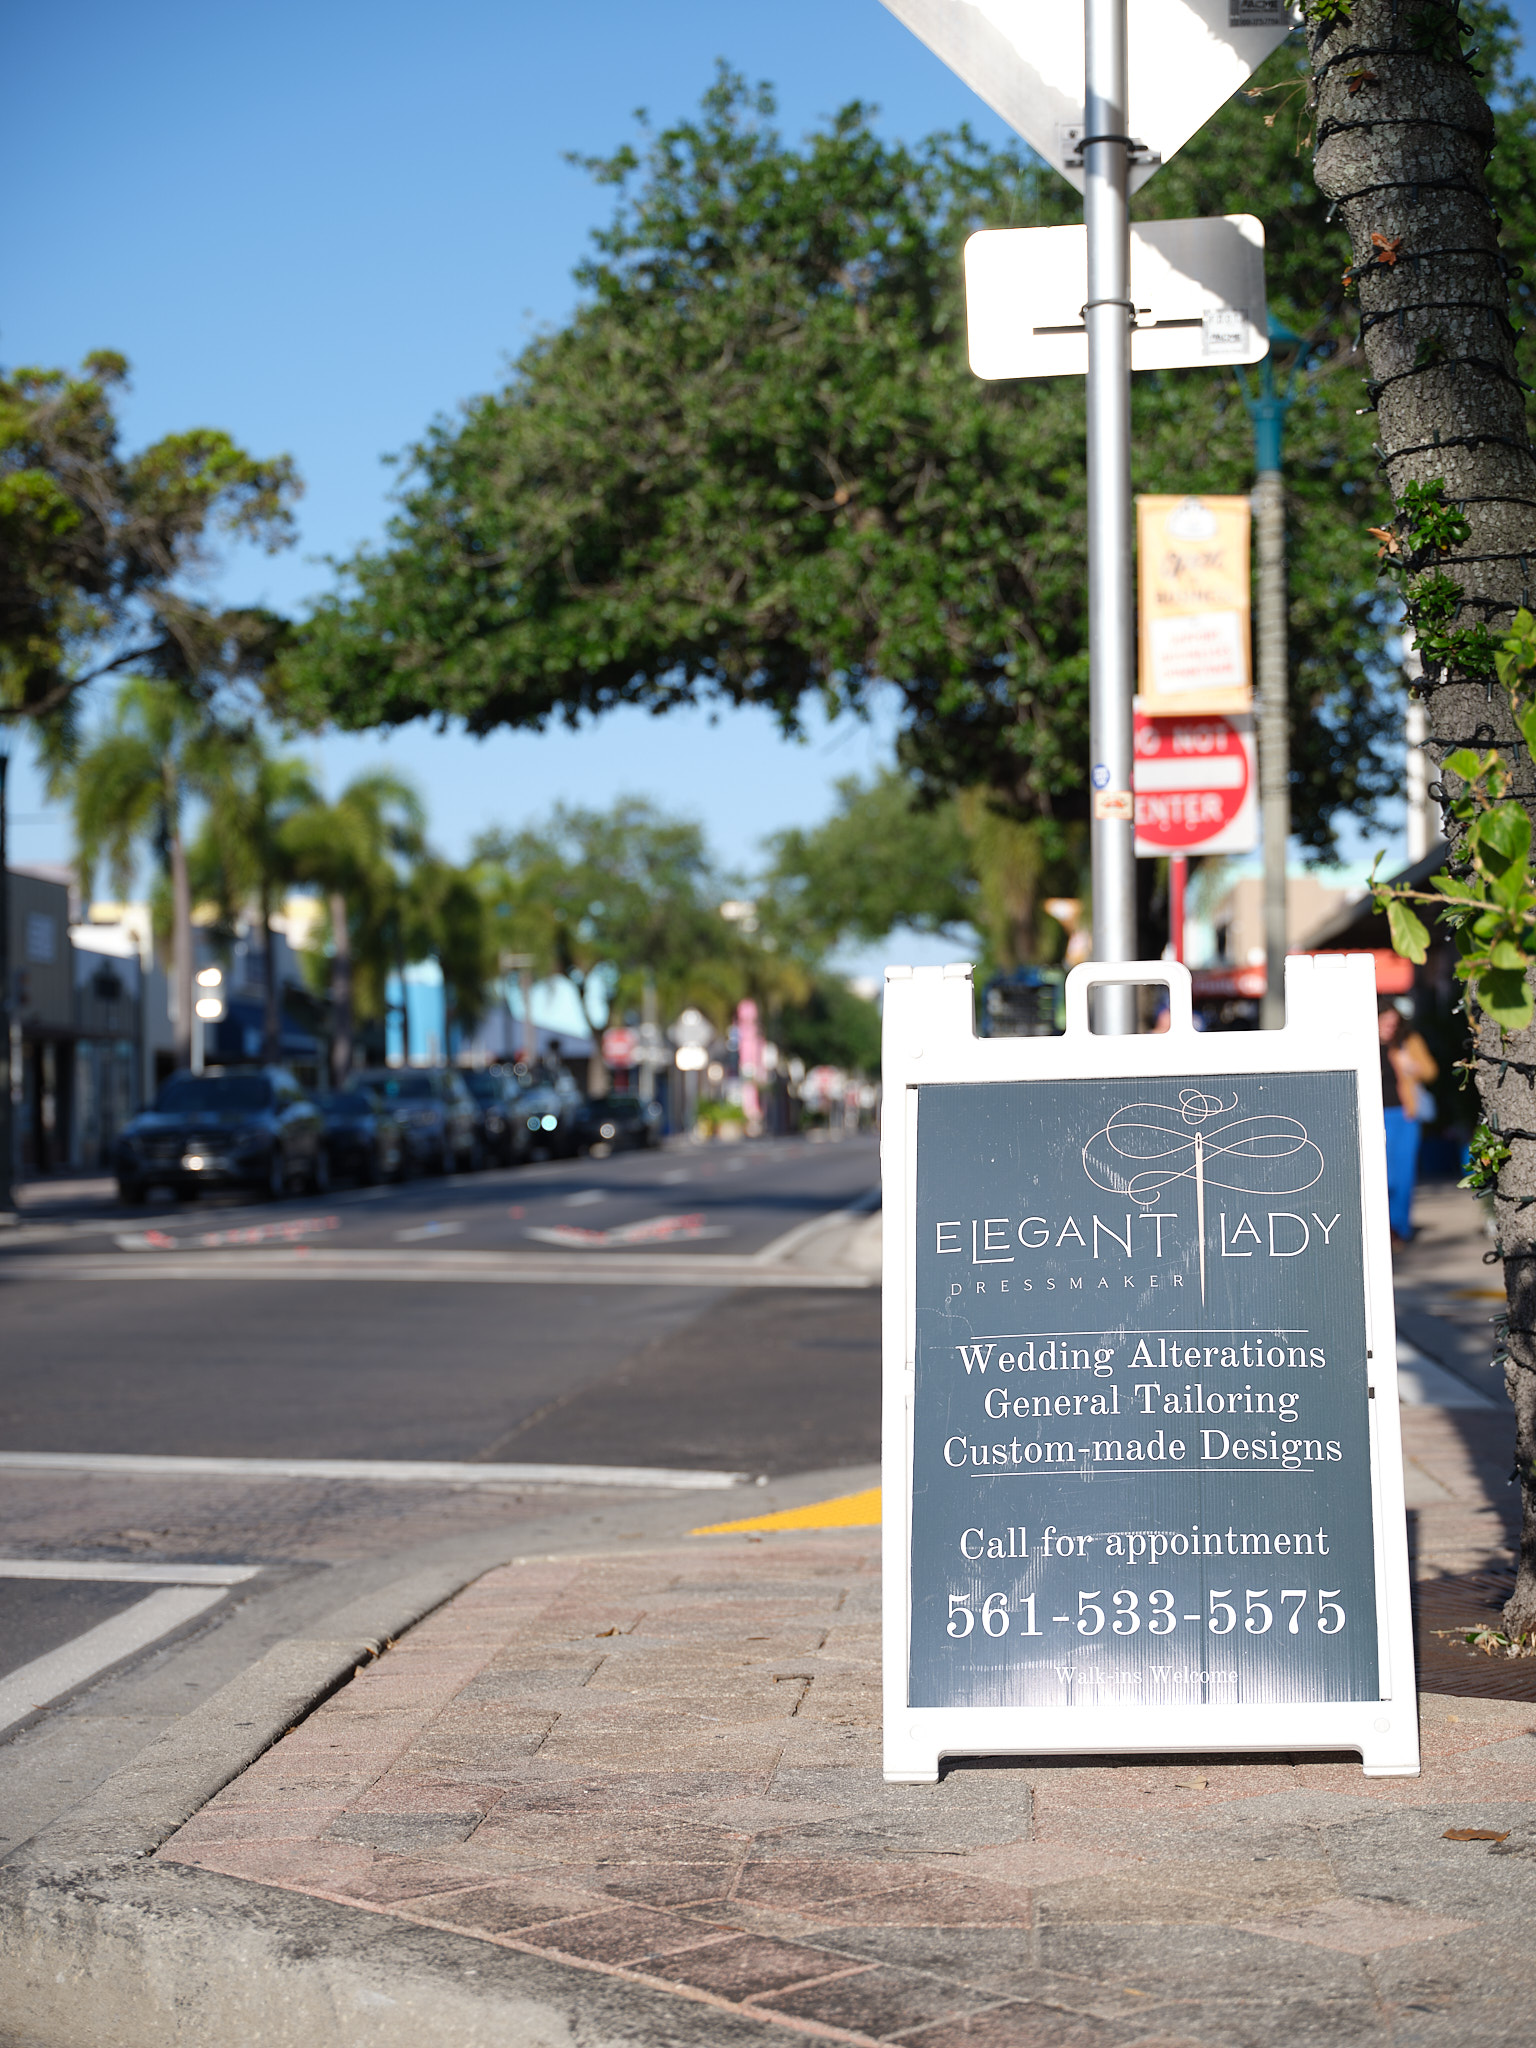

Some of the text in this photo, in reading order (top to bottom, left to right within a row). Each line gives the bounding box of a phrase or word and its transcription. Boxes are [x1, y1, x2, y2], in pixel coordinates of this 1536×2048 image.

[1172, 723, 1228, 754] NOT
[1135, 793, 1224, 825] ENTER
[937, 1212, 1341, 1264] ELEGANT LADY
[951, 1274, 1184, 1296] DRESSMAKER
[955, 1338, 1326, 1378] Wedding Alterations
[984, 1382, 1299, 1423] General Tailoring
[943, 1428, 1343, 1470] Custom-made Designs
[960, 1524, 1330, 1565] Call for appointment
[946, 1588, 1346, 1638] 561-533-5575
[1054, 1664, 1239, 1685] Walk-ins Welcome
